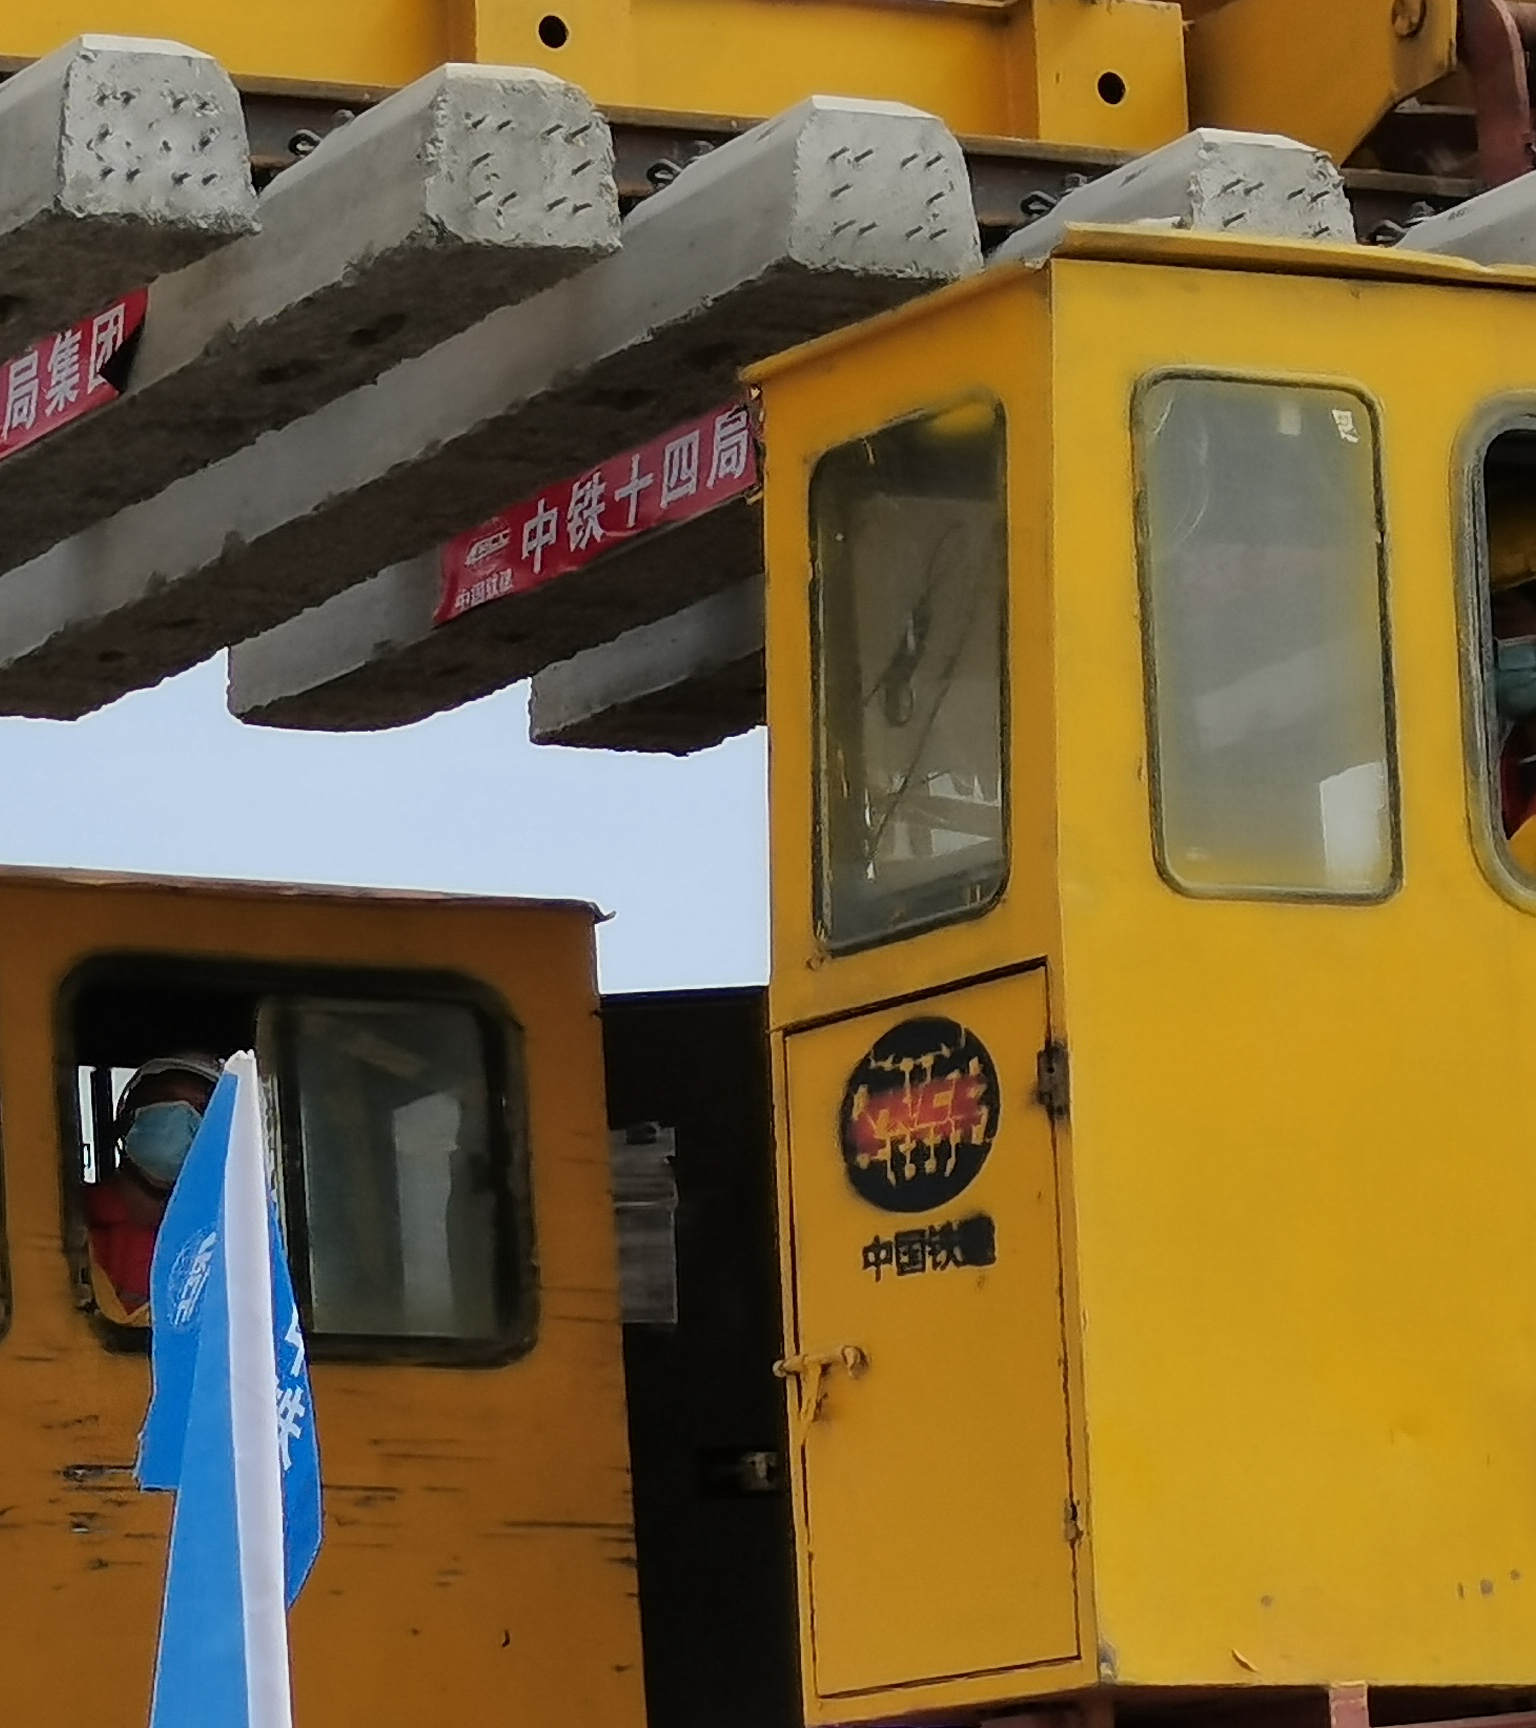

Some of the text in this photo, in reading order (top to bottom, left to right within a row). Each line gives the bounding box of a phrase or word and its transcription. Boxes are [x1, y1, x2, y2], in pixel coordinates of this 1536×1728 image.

[520, 407, 750, 574] 中铁十四局
[862, 1213, 997, 1283] 中国铁
